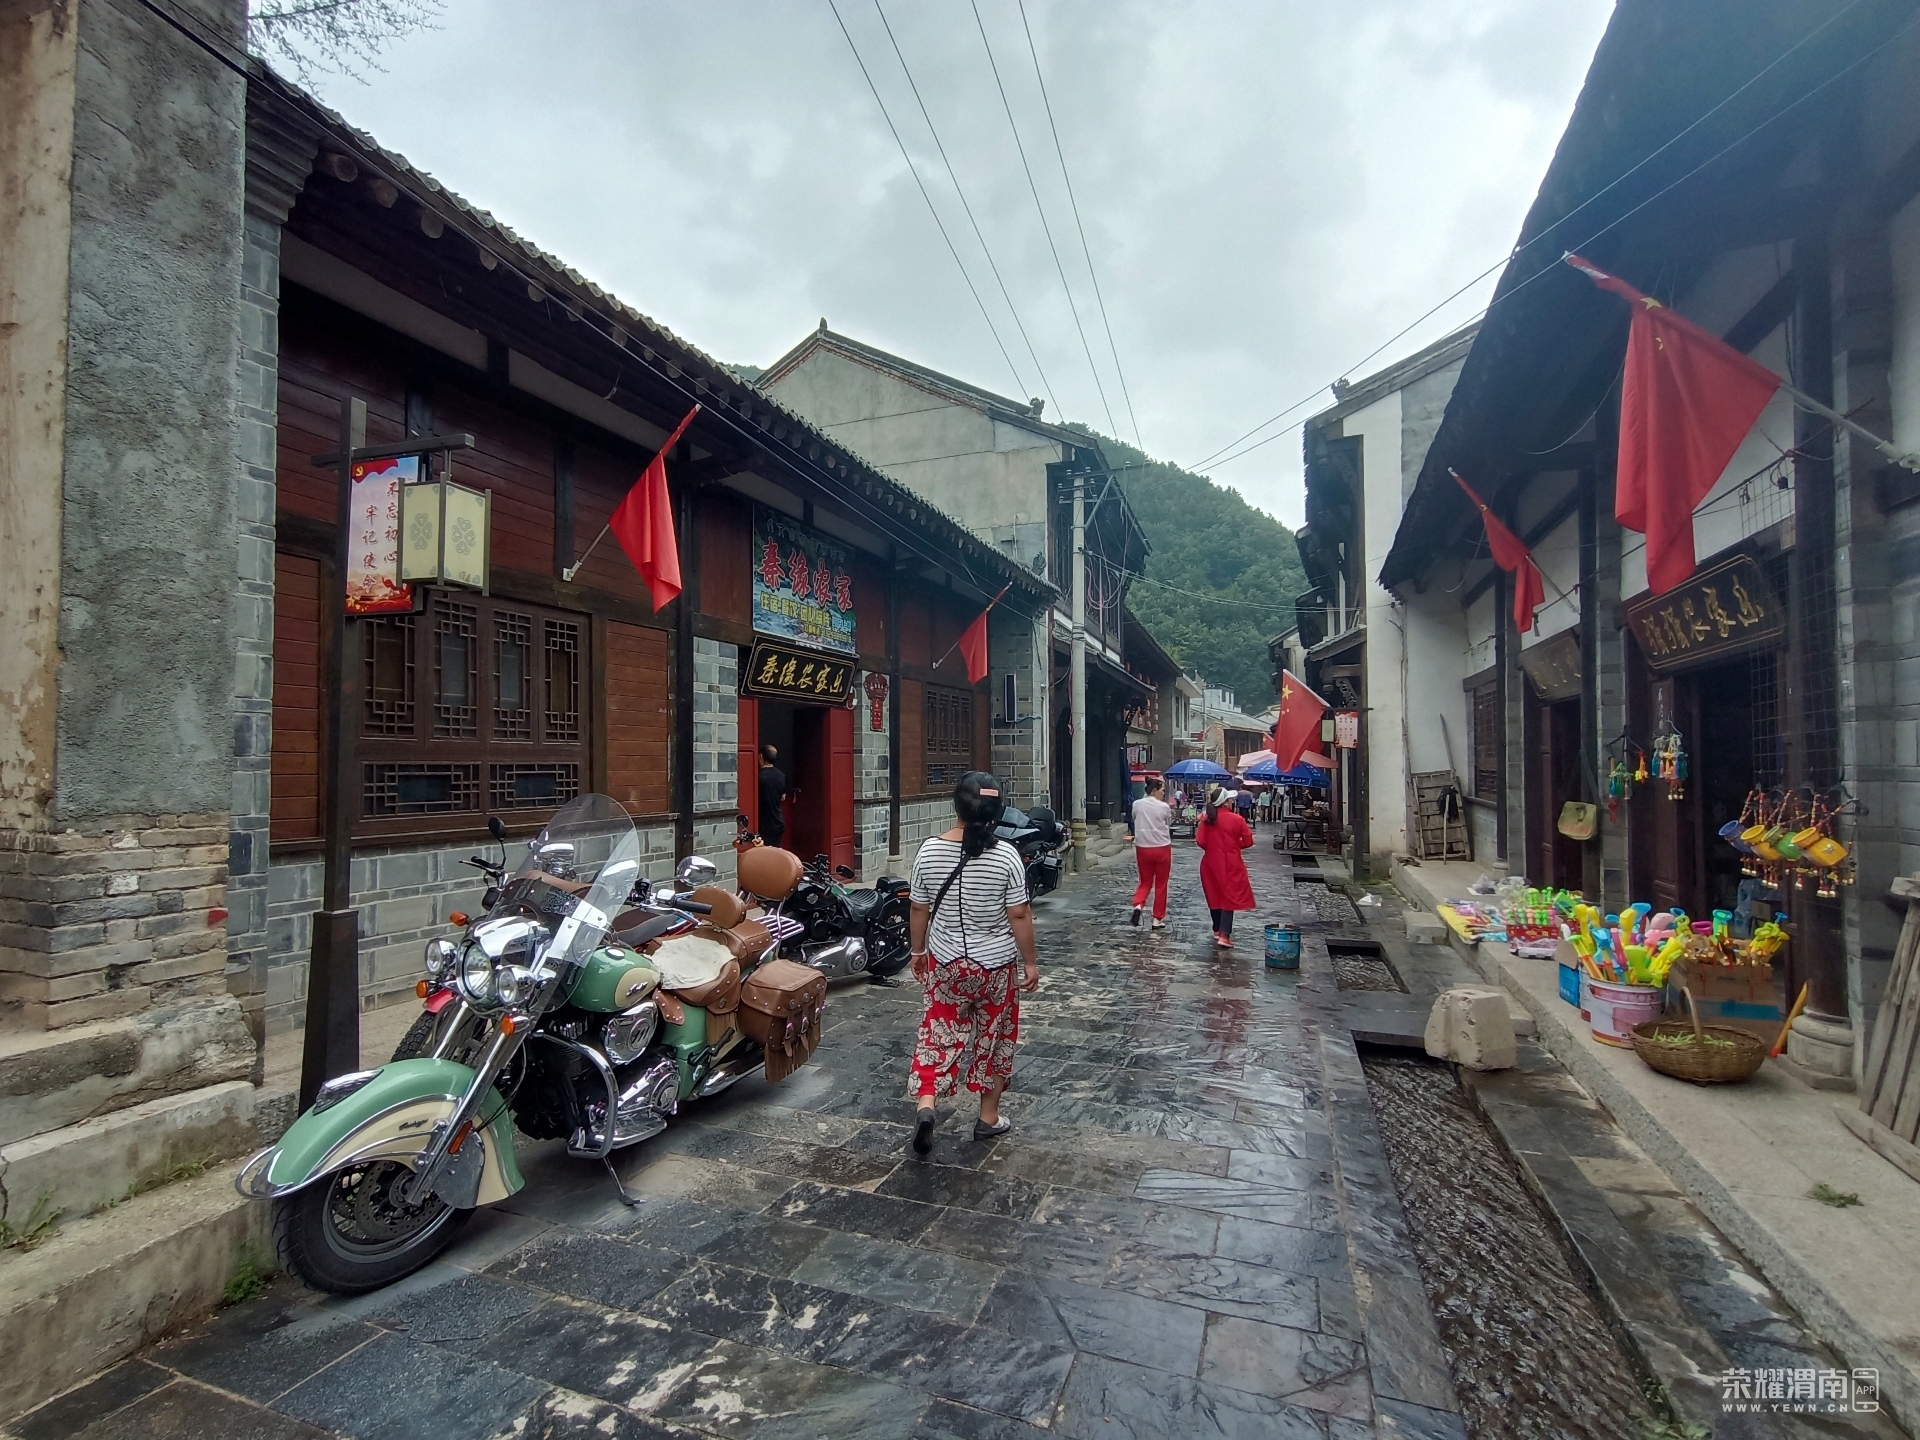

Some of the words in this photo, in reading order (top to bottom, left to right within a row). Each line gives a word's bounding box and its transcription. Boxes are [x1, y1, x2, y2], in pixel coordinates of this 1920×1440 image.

[362, 505, 379, 594] 牢记使命
[384, 482, 399, 564] 不忘初心
